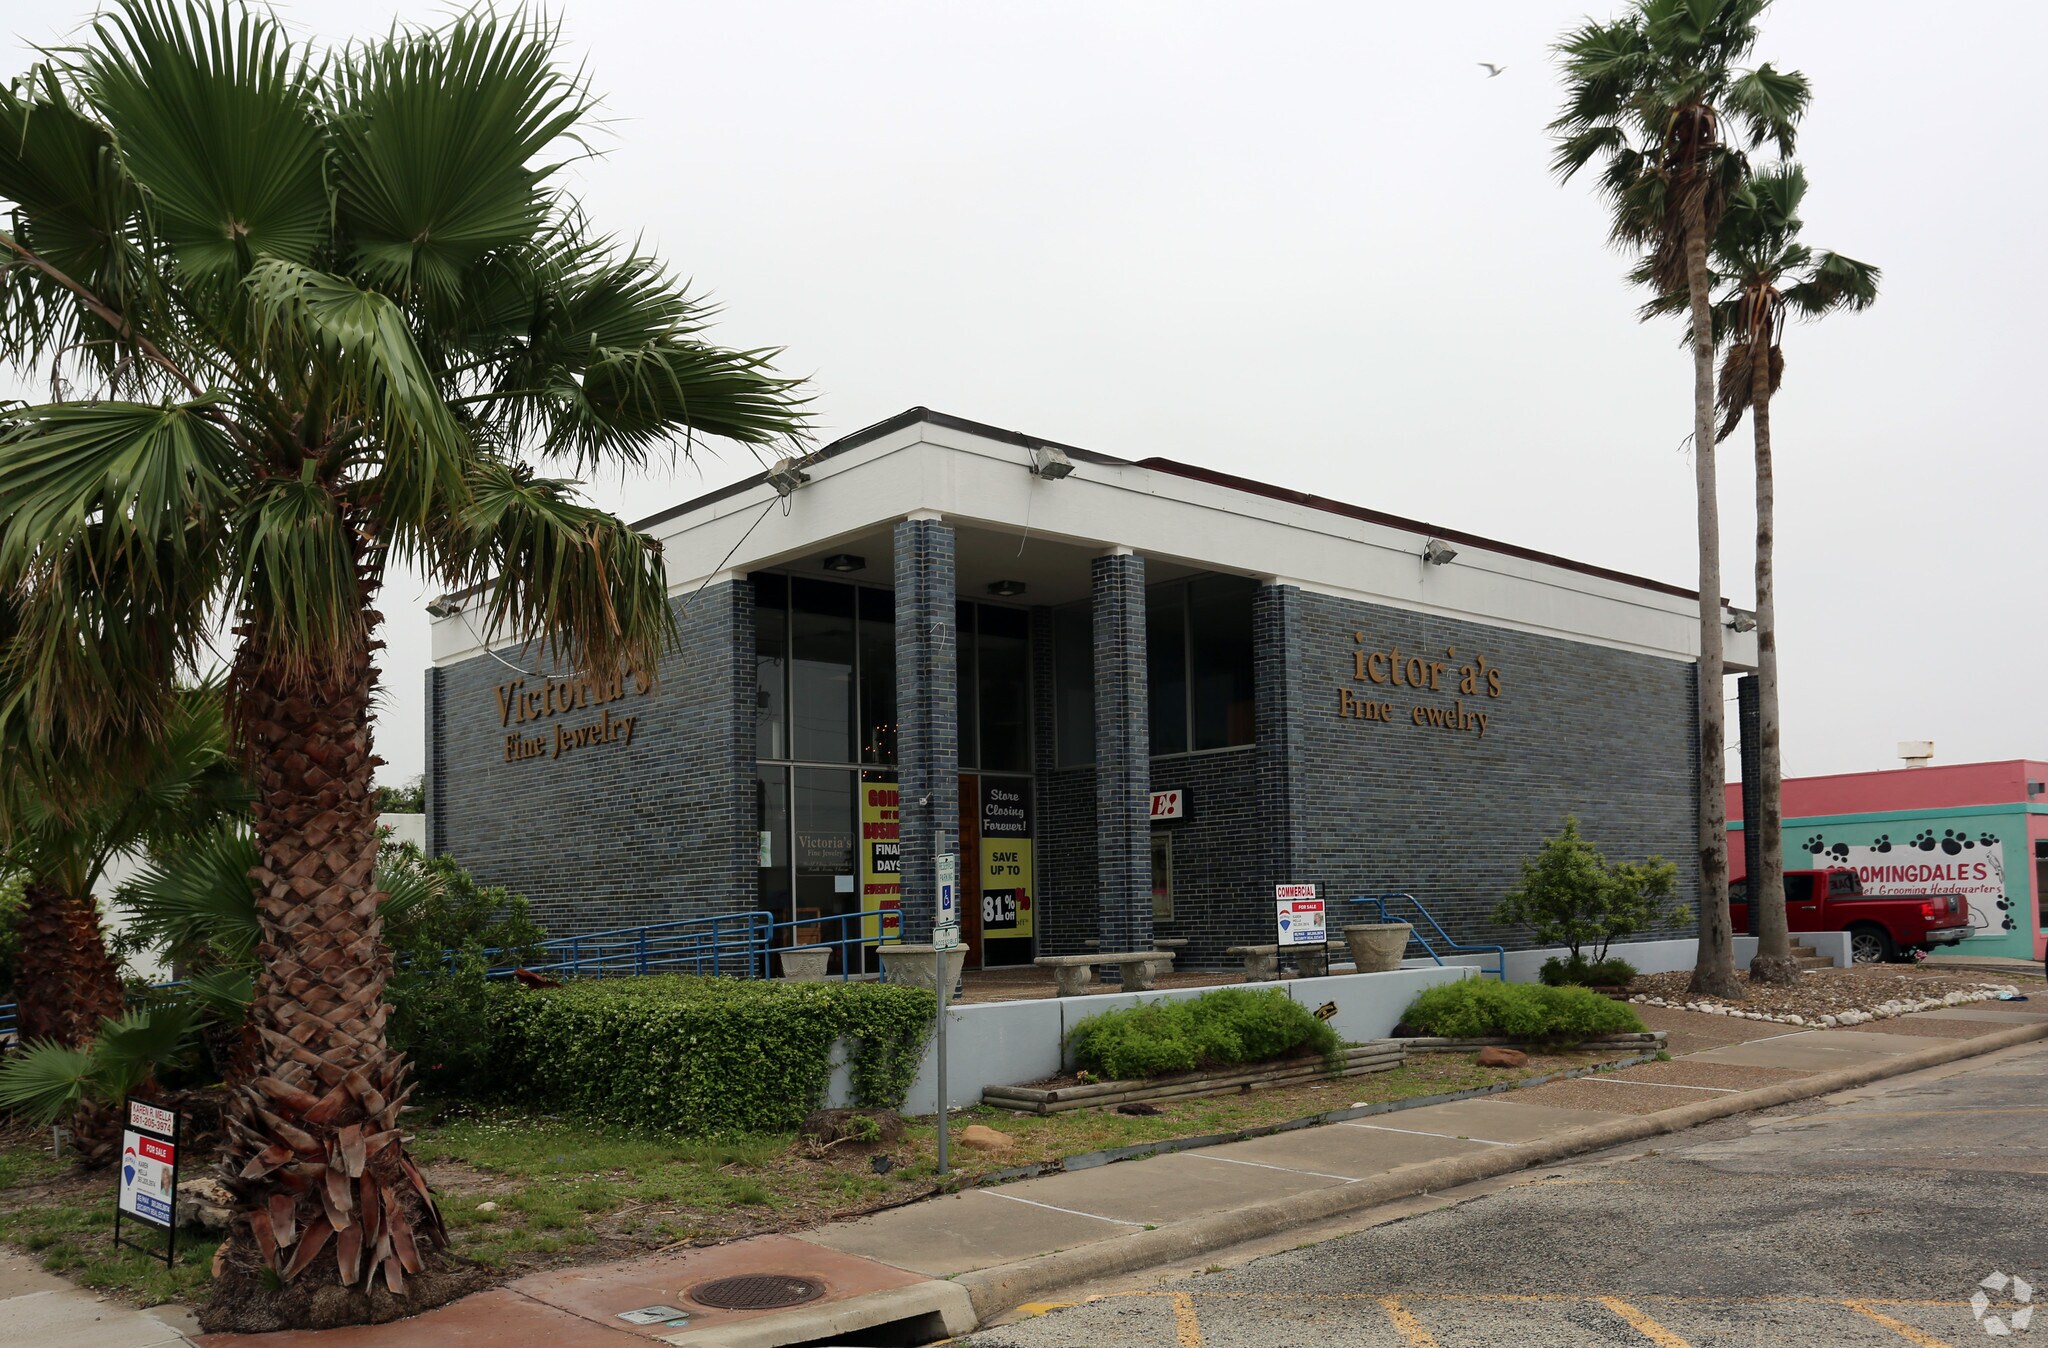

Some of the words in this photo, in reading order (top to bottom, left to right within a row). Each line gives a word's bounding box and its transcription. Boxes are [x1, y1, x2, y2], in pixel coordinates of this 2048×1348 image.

[1352, 631, 1501, 698] ictora's
[1337, 687, 1393, 722] Fine
[1412, 699, 1489, 739] ewelry
[504, 731, 547, 763] Fine
[550, 709, 637, 760] Jewelry
[990, 788, 1020, 801] Store
[985, 803, 1024, 819] Closing
[983, 818, 1027, 831] Forever!
[799, 835, 852, 849] Victoria's
[992, 851, 1018, 862] SAVE
[990, 865, 1005, 876] UP
[1006, 865, 1020, 876] TO
[1827, 862, 1987, 883] OMINGDALES
[1277, 886, 1314, 898] COMMERCIAL
[1862, 886, 1874, 895] et
[1879, 884, 1927, 896] Grooming
[1930, 883, 2002, 894] Headquarters
[132, 1103, 149, 1116] KAREN
[155, 1109, 172, 1122] MELLA
[132, 1113, 172, 1133] 361-205-3974
[145, 1144, 156, 1154] FOR
[155, 1147, 167, 1158] SALE
